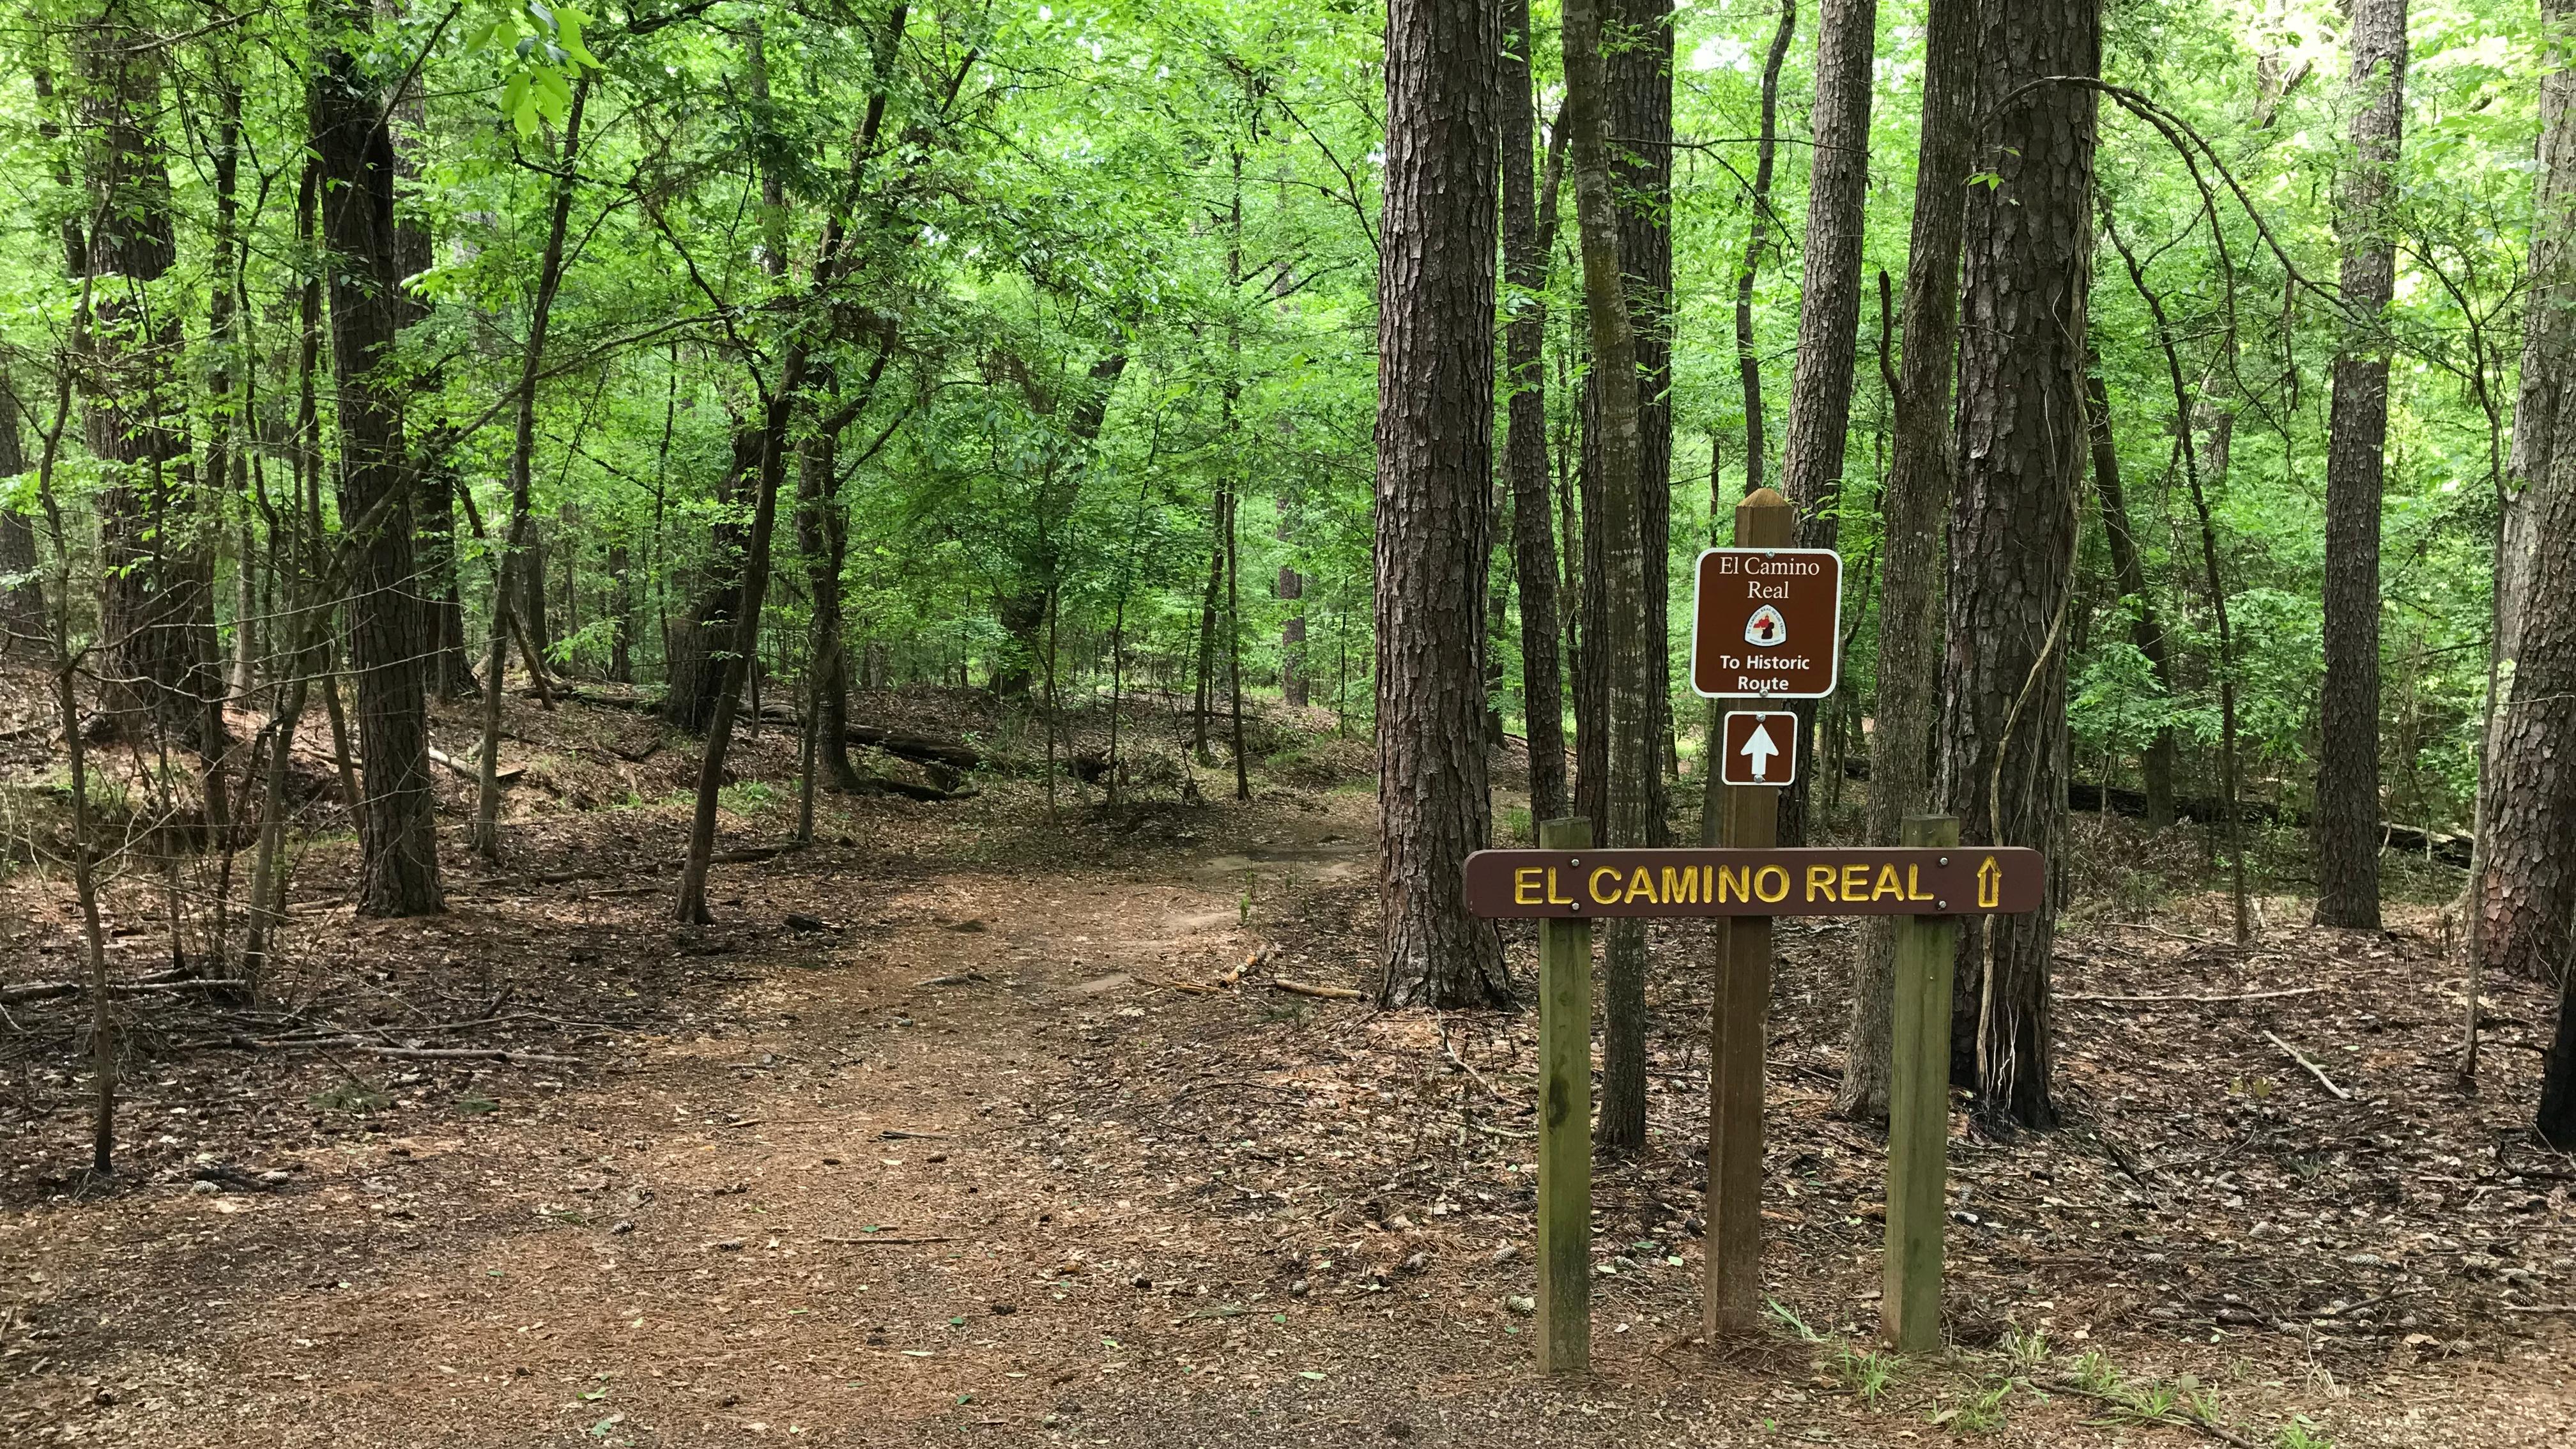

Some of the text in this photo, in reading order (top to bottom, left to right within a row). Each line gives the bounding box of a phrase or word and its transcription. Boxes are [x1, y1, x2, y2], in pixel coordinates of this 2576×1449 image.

[1719, 556, 1820, 576] El Camino
[1747, 581, 1789, 599] Real
[1720, 654, 1810, 670] To Historic
[1738, 676, 1789, 691] Route
[1514, 864, 1935, 905] EL CAMINO REAL
